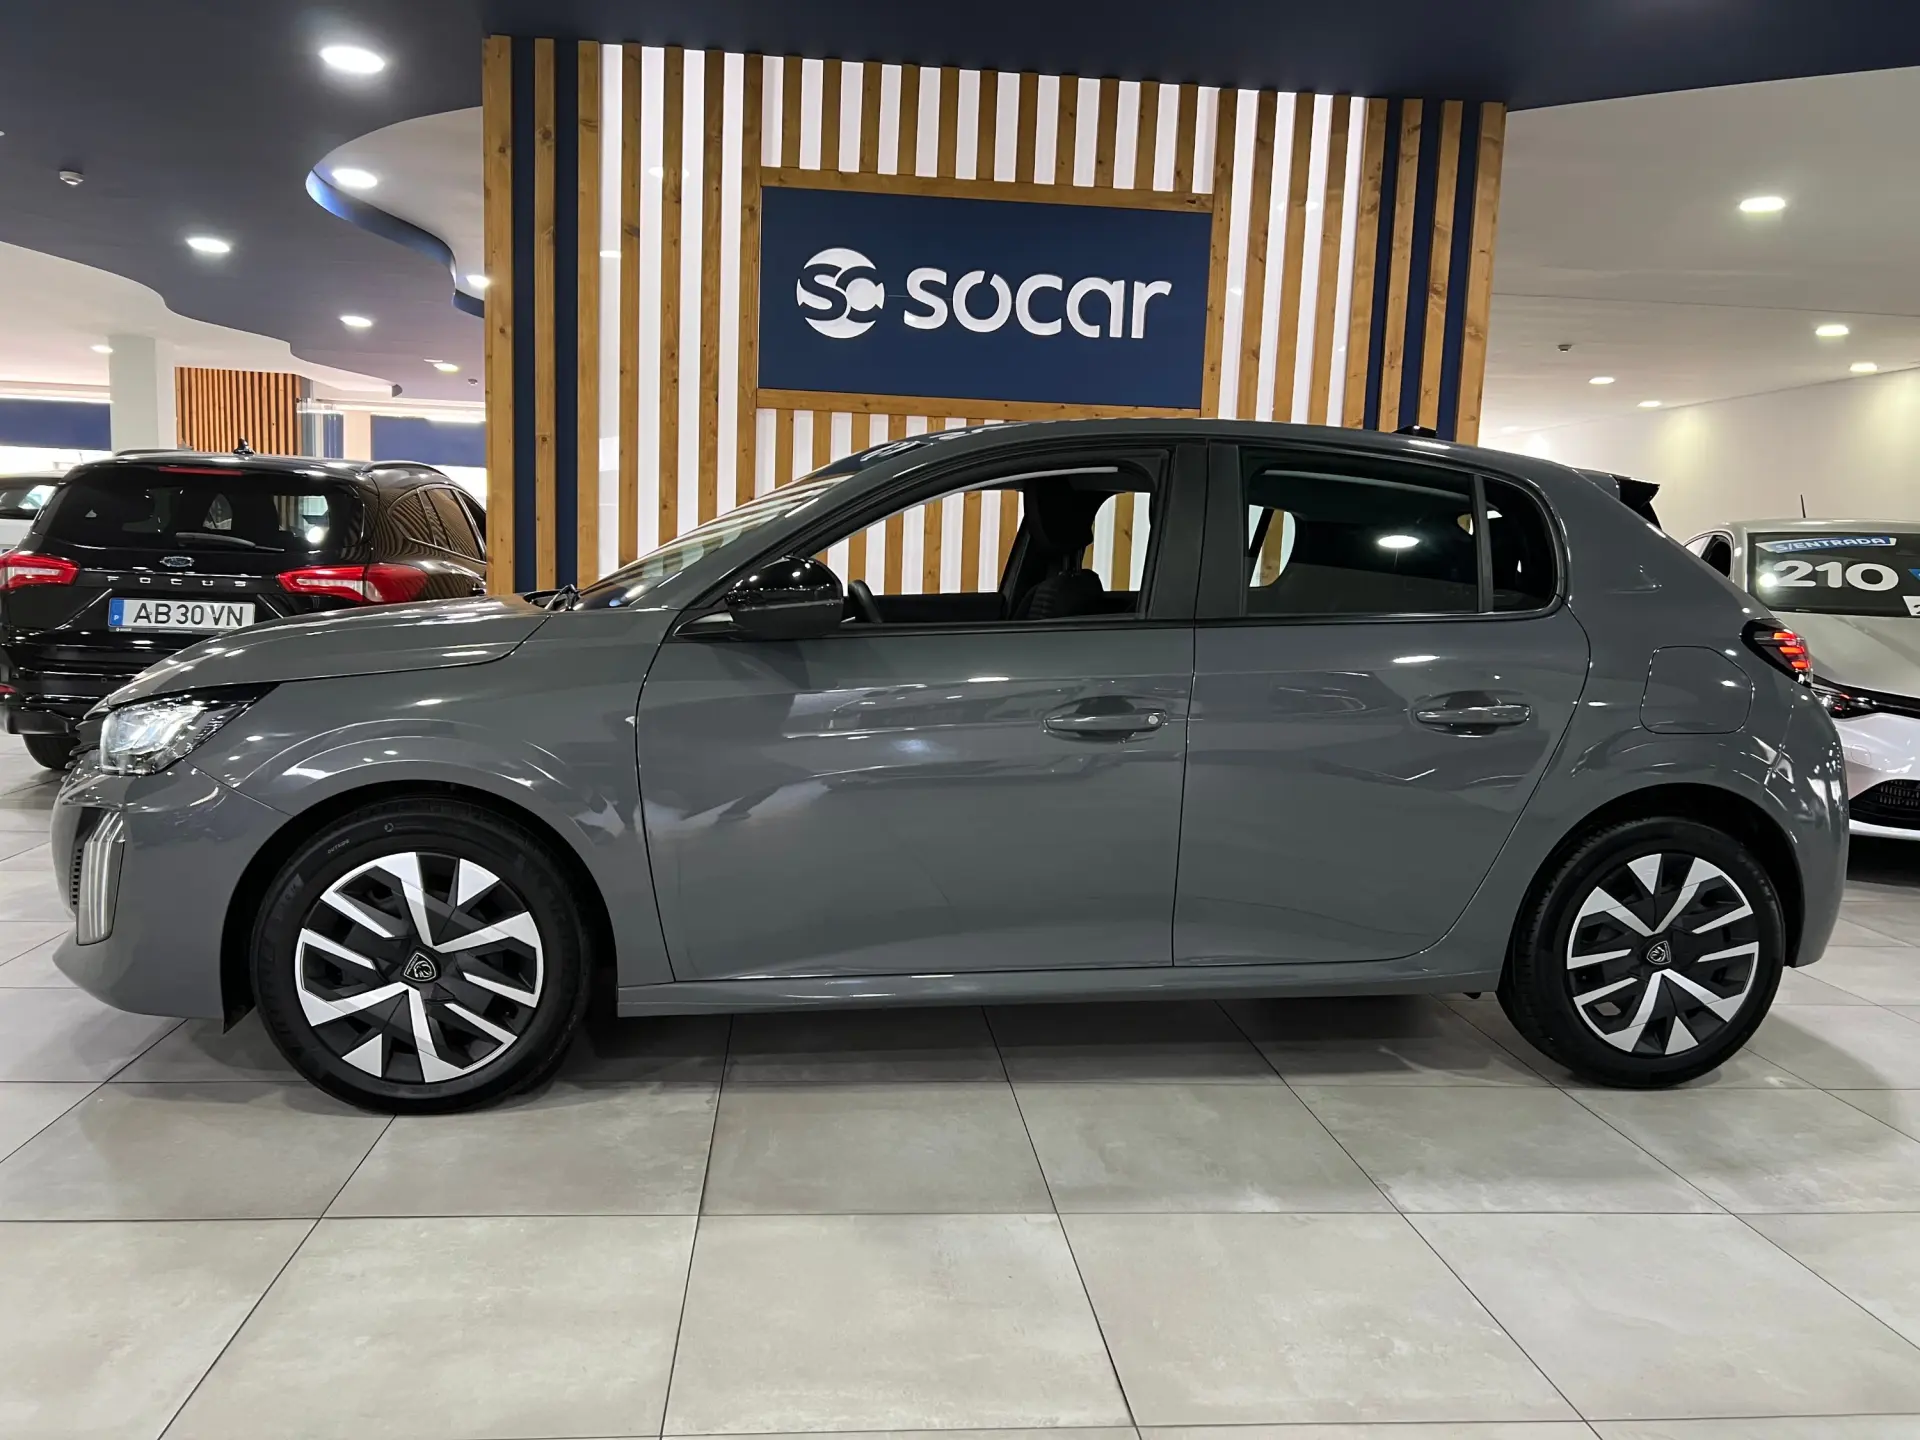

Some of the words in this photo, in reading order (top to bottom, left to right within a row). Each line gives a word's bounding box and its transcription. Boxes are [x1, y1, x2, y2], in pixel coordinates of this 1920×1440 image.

[1775, 537, 1886, 552] S/ENTRADA
[107, 575, 247, 587] FOCUS
[1773, 560, 1899, 591] 210
